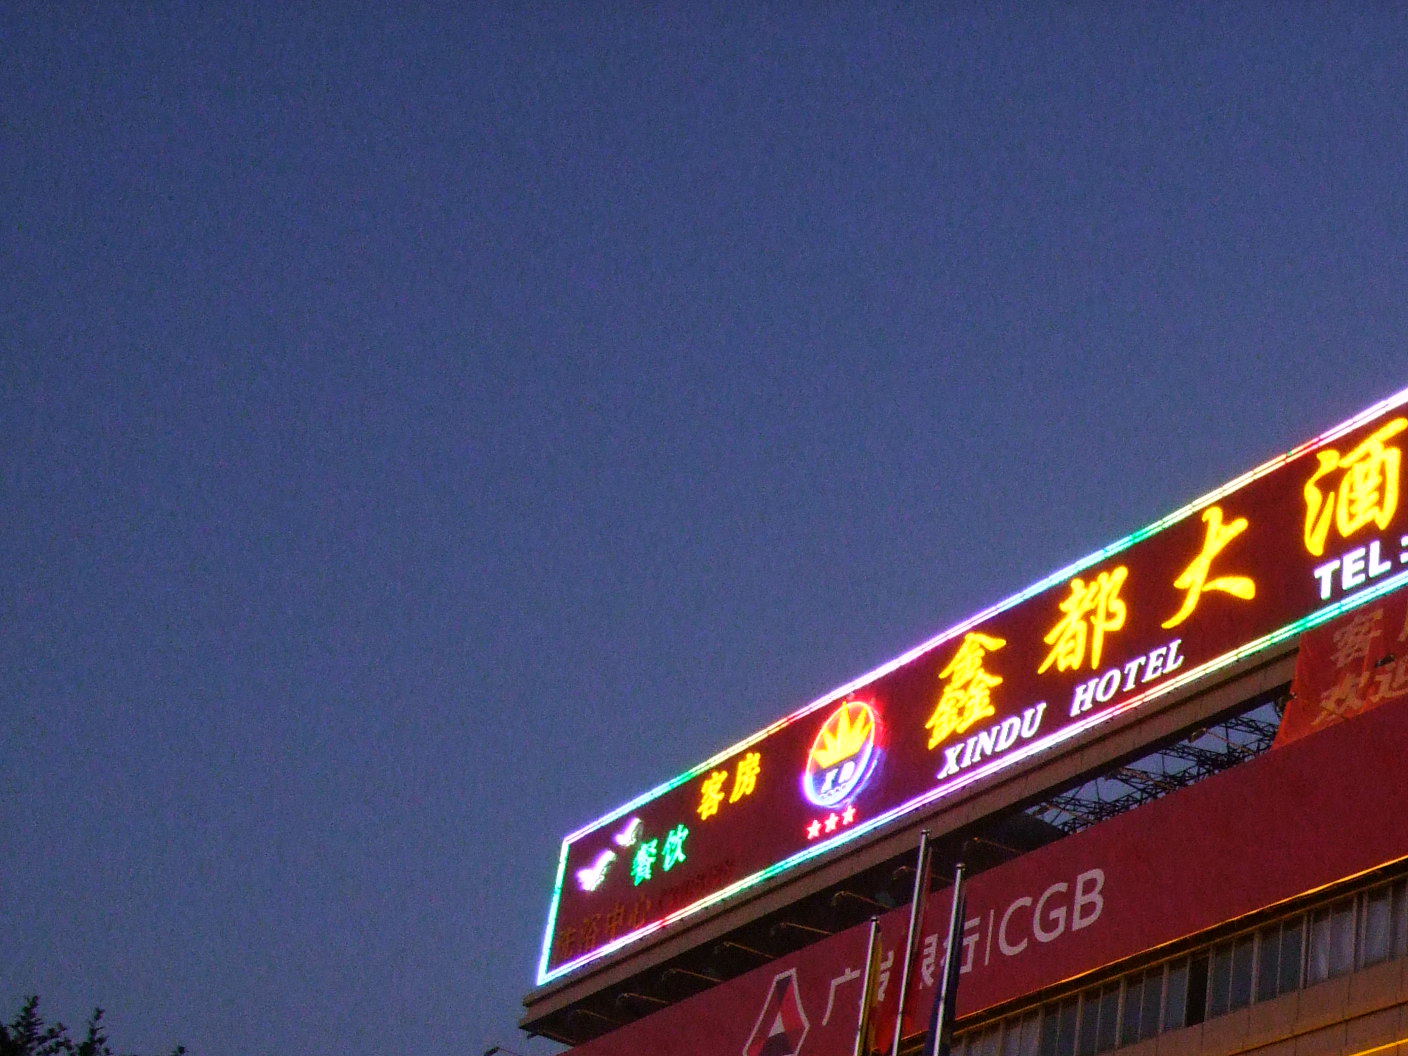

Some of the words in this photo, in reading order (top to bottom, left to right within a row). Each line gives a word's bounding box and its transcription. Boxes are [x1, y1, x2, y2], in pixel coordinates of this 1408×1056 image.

[937, 702, 1047, 780] XINDU
[1069, 639, 1185, 717] HOTEL
[696, 752, 762, 821] 客房
[999, 868, 1105, 957] CGB
